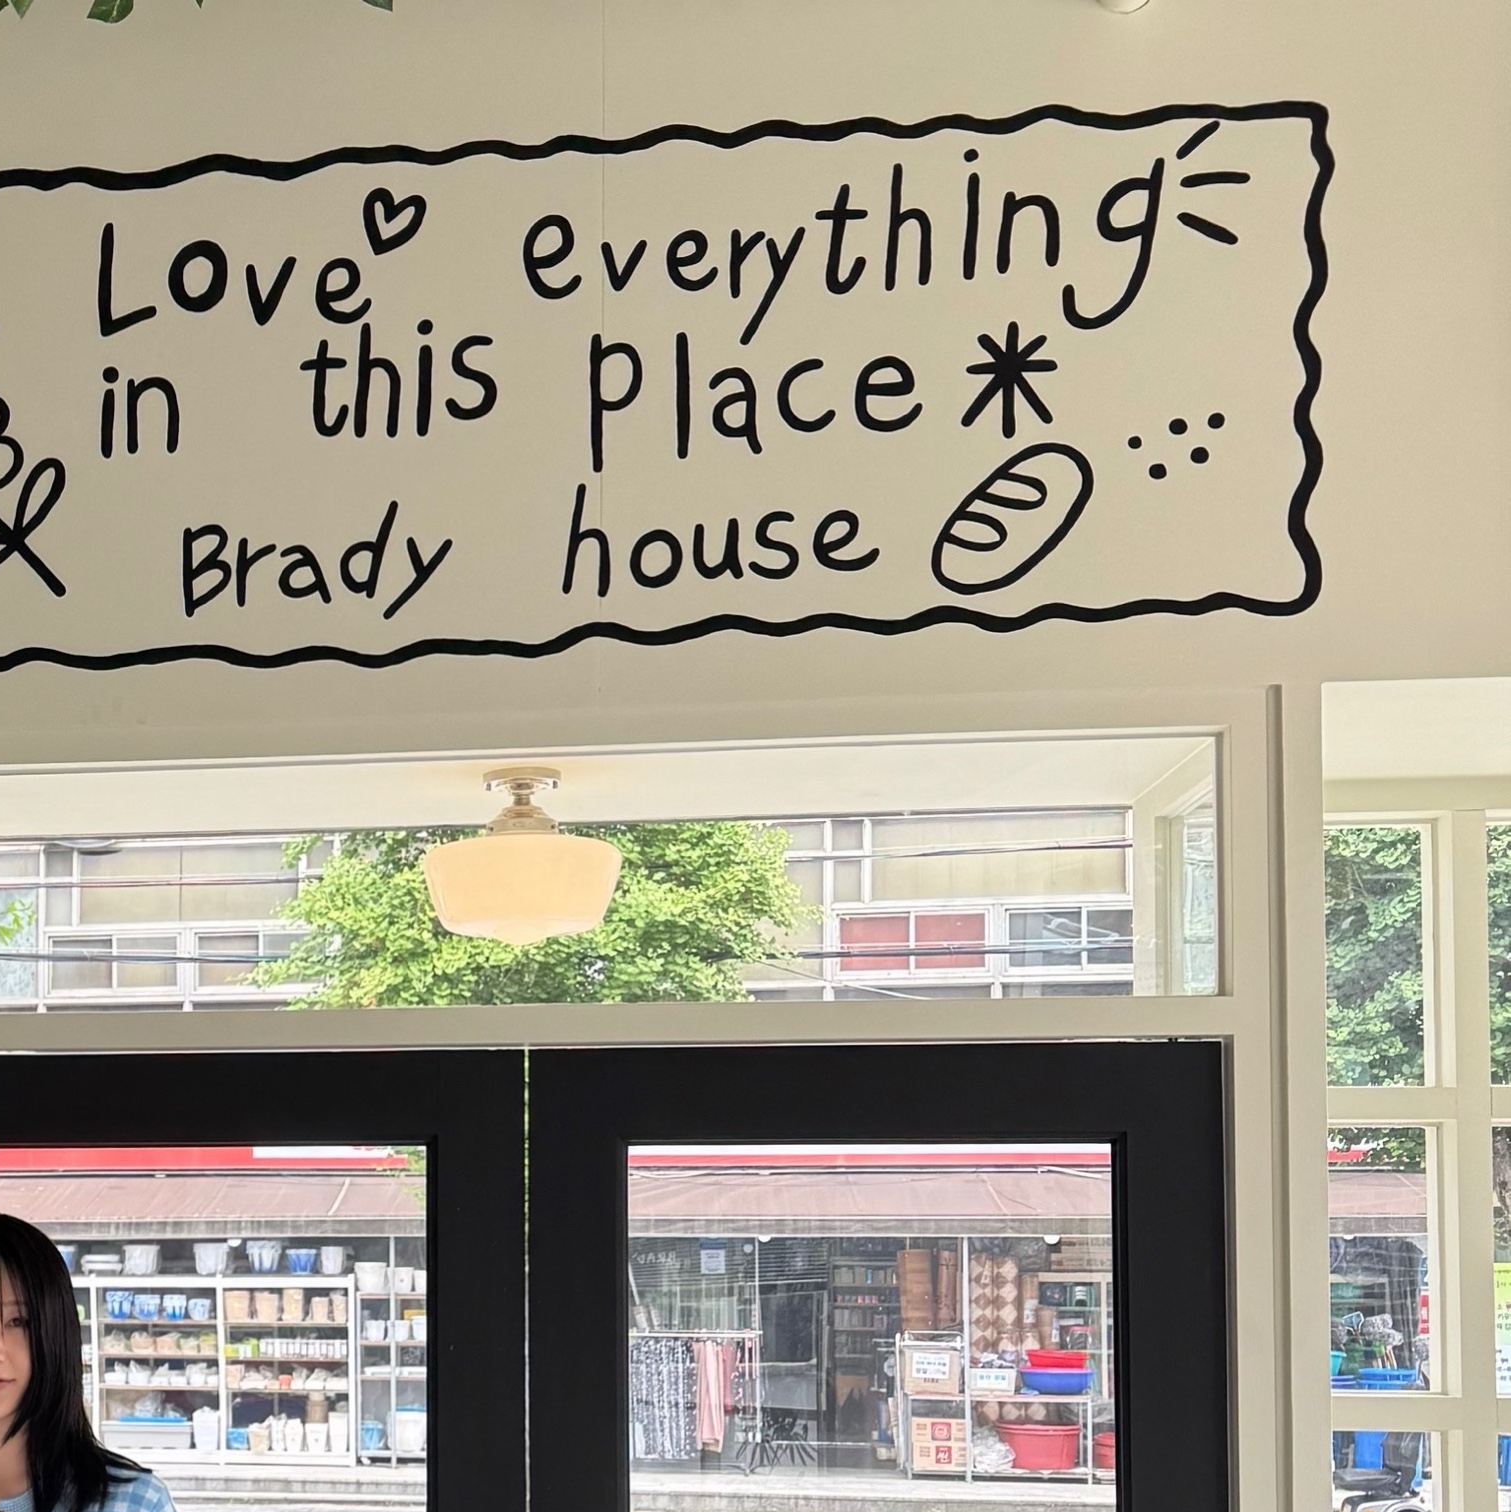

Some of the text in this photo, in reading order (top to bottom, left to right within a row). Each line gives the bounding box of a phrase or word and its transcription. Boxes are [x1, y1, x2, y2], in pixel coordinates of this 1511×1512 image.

[98, 223, 371, 337] Love
[523, 149, 1164, 345] everything
[101, 320, 922, 472] in this place
[183, 484, 879, 619] Brady house
